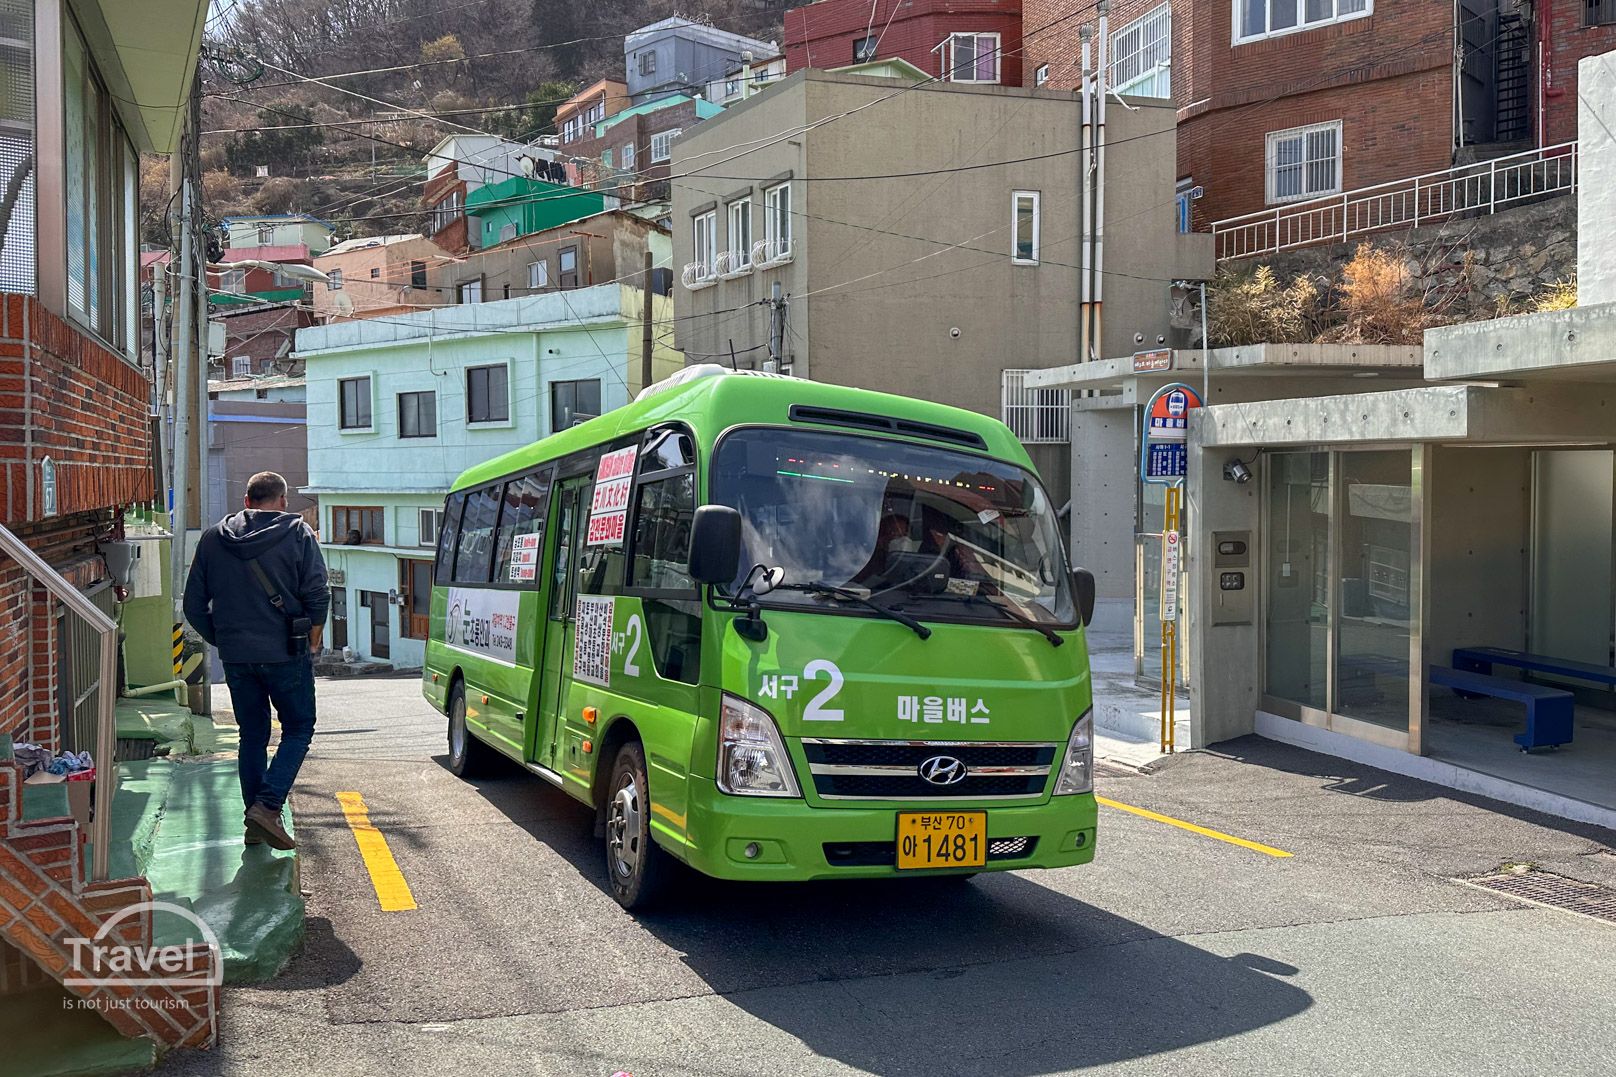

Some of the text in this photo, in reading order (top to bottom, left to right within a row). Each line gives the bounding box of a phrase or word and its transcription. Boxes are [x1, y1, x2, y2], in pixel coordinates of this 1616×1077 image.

[1154, 418, 1185, 428] 마을버
[589, 514, 625, 542] 감천문화마을
[623, 613, 642, 678] 2
[757, 658, 845, 722] 서구 2
[897, 695, 990, 725] 마을버스
[920, 815, 966, 831] 부산 70
[902, 832, 980, 863] 아 1481
